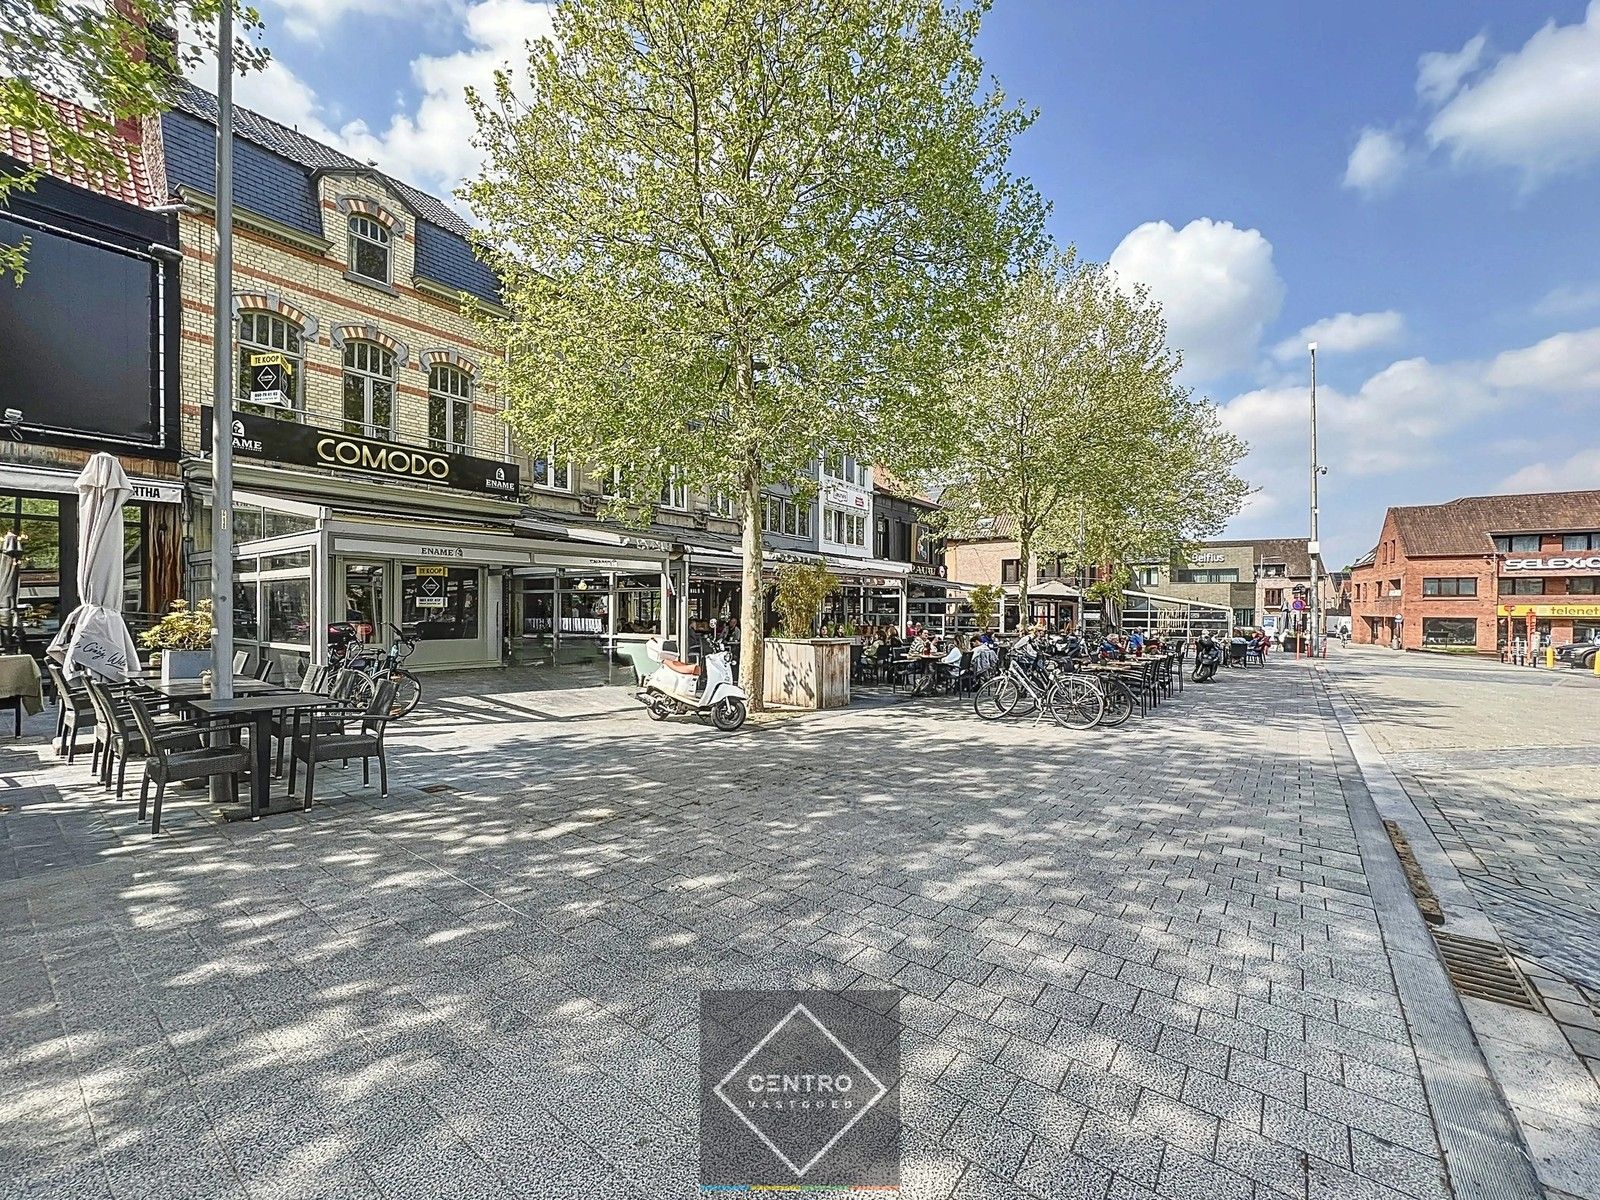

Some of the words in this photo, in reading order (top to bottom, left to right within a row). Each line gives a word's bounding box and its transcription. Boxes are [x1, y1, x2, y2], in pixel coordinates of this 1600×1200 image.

[262, 355, 280, 363] KOOP
[232, 437, 263, 450] AME
[317, 438, 450, 479] COMODO
[486, 479, 515, 491] ENAME
[132, 485, 161, 499] RTHA
[421, 547, 454, 557] ENAME
[1191, 552, 1225, 563] Belfius
[1550, 606, 1600, 615] telenet
